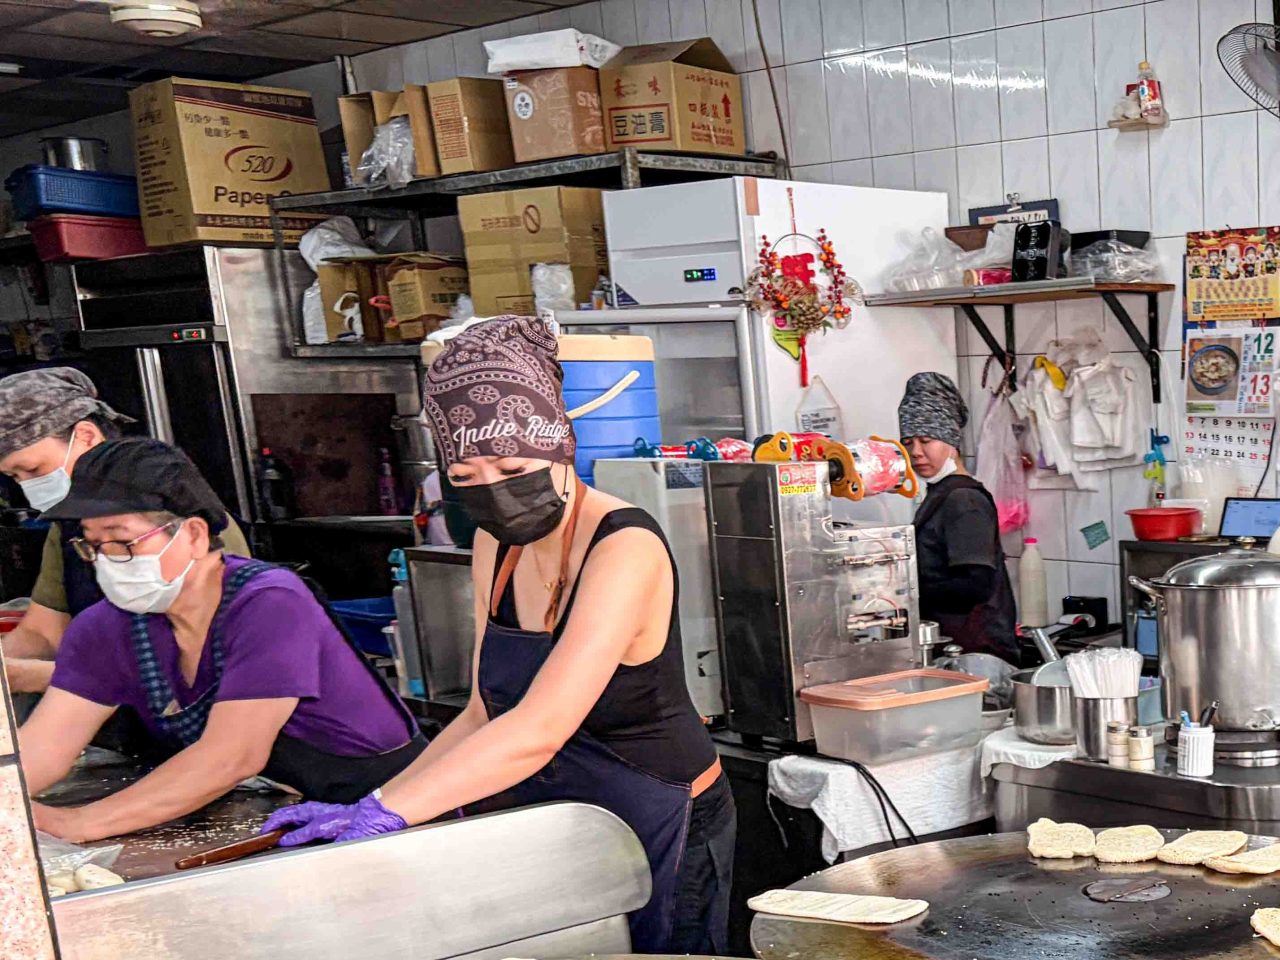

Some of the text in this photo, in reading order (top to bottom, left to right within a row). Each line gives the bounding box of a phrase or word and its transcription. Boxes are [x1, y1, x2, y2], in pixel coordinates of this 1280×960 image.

[241, 154, 274, 174] 520
[213, 185, 274, 208] Paper
[1254, 332, 1275, 354] 12
[1250, 374, 1271, 396] 13
[1212, 418, 1219, 426] 8
[1225, 419, 1232, 427] 9
[453, 415, 570, 456] Indie Ridge
